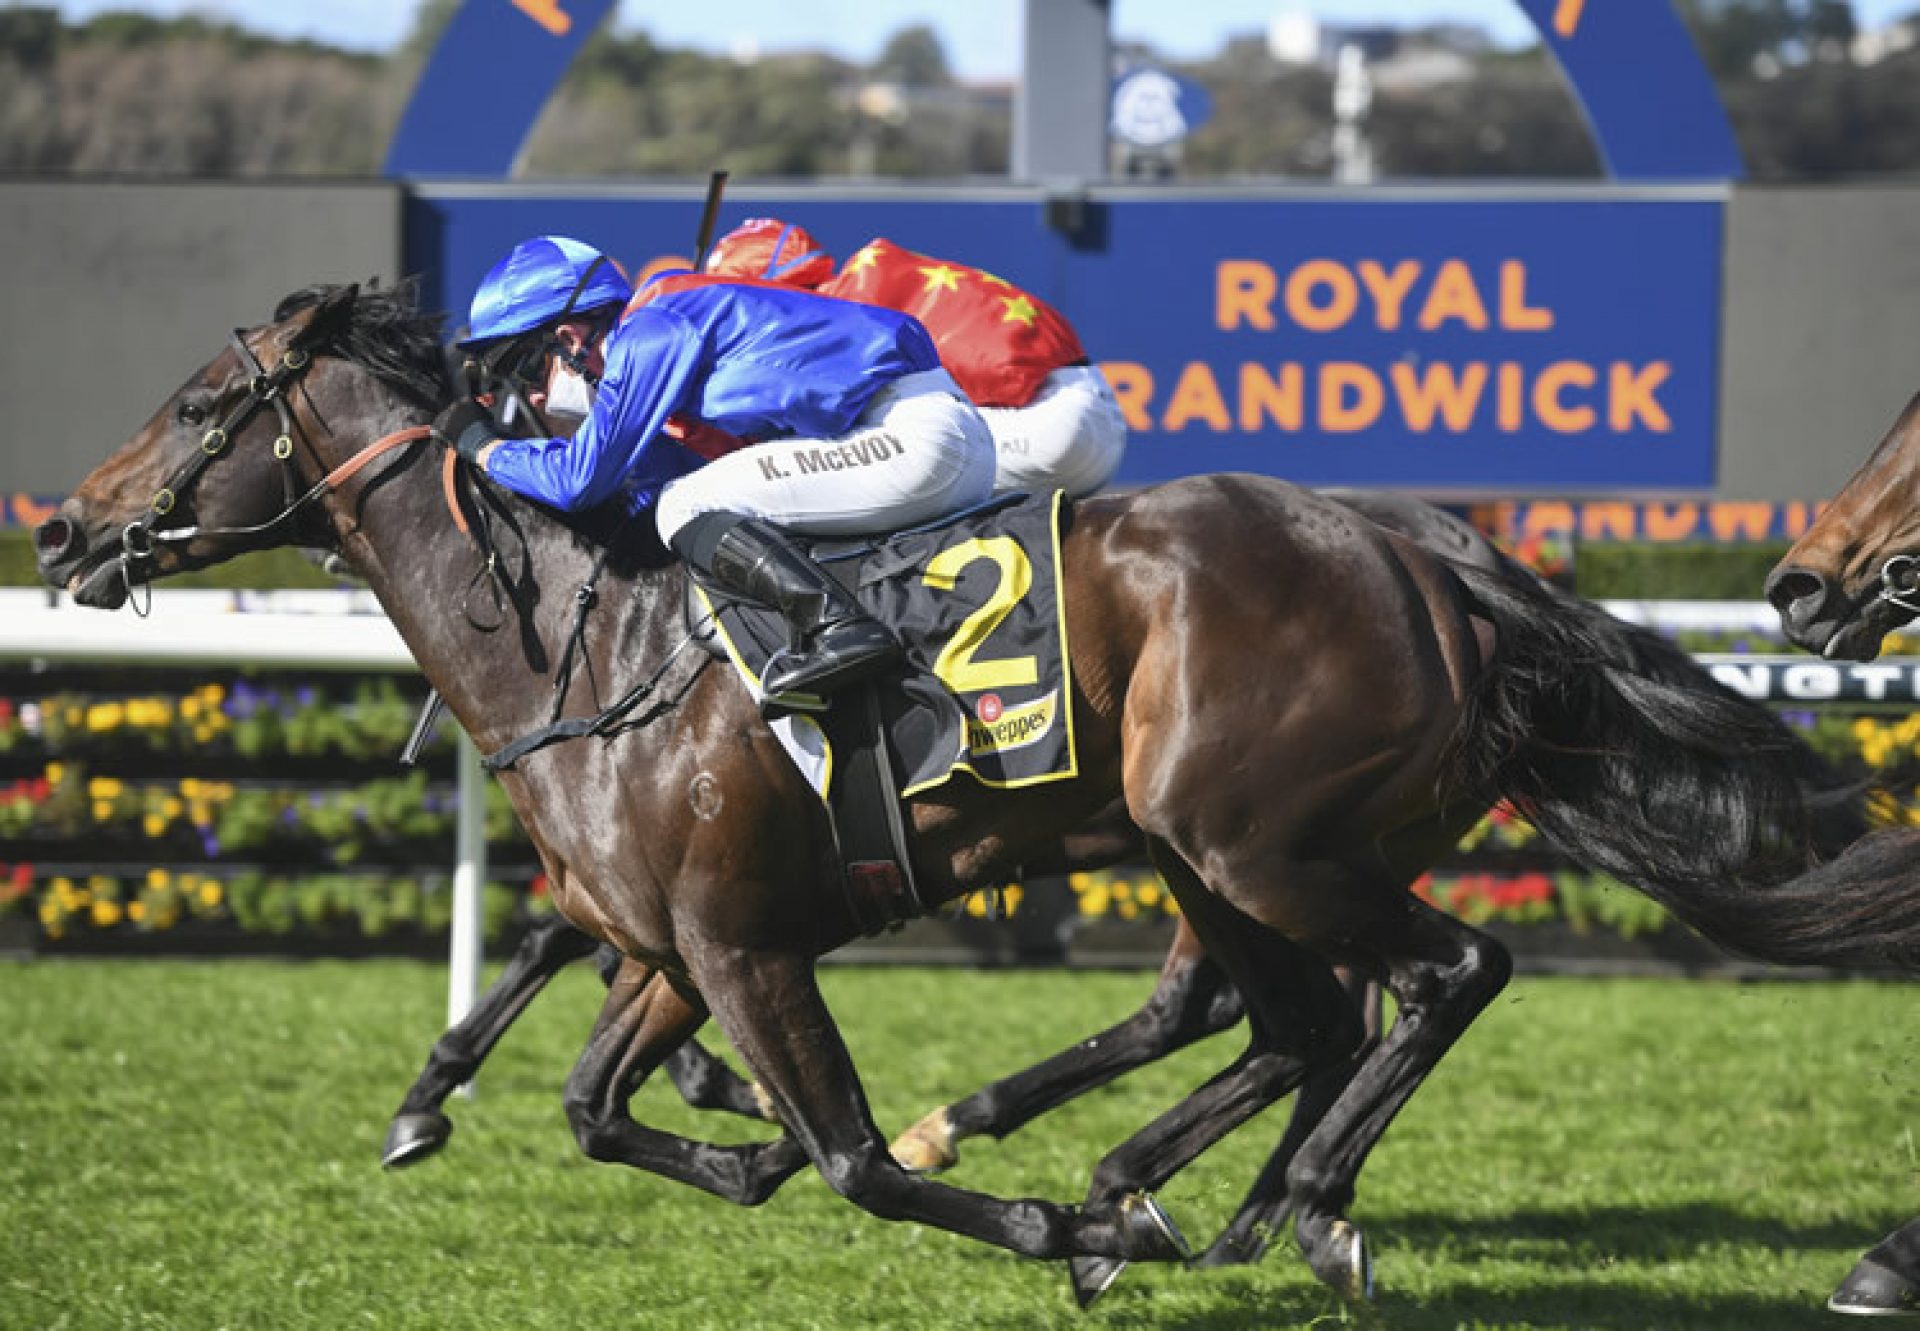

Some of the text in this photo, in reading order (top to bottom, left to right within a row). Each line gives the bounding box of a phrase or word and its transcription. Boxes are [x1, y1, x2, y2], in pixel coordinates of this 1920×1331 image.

[1216, 260, 1554, 331] ROYAL
[1102, 362, 1672, 433] RANDWICK
[757, 455, 791, 481] K.
[921, 536, 1039, 692] 2
